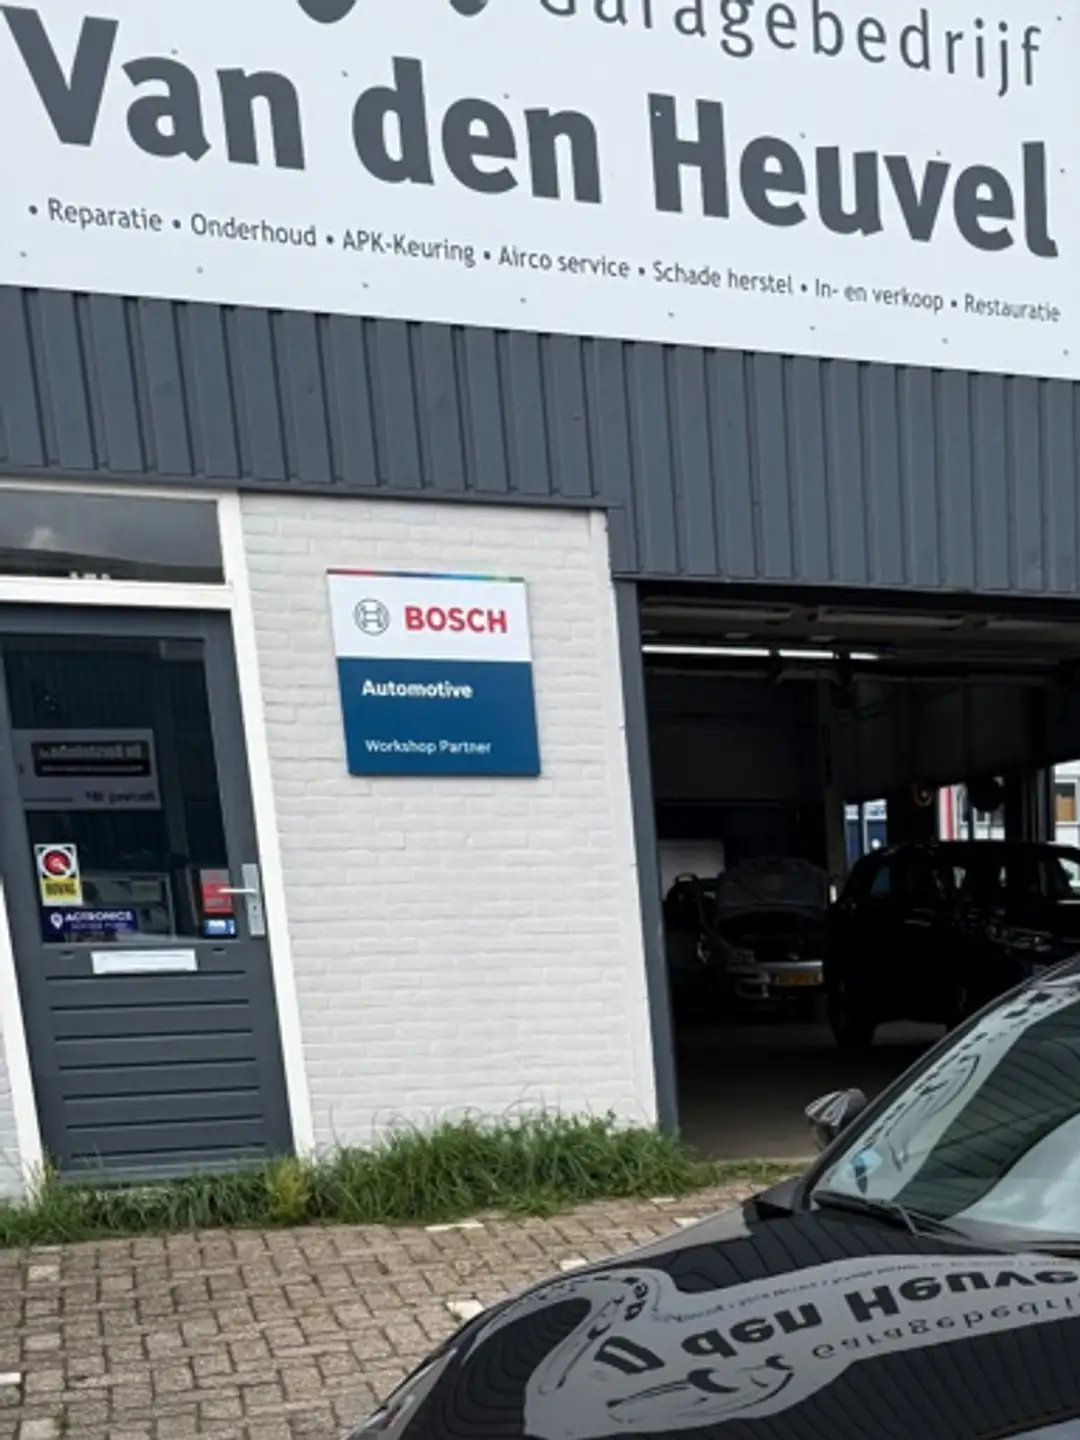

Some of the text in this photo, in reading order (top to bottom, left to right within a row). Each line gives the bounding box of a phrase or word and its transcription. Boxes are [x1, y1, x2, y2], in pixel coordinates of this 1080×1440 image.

[2, 6, 1059, 258] Van den Heuvel
[48, 198, 1061, 322] Reparatie Onderhoud APK-Keuring Airco service Schade herstel In- en verkoop Restauratie
[404, 605, 508, 634] BOSCH
[361, 679, 475, 699] Automotive
[364, 738, 493, 755] Workshop Partner
